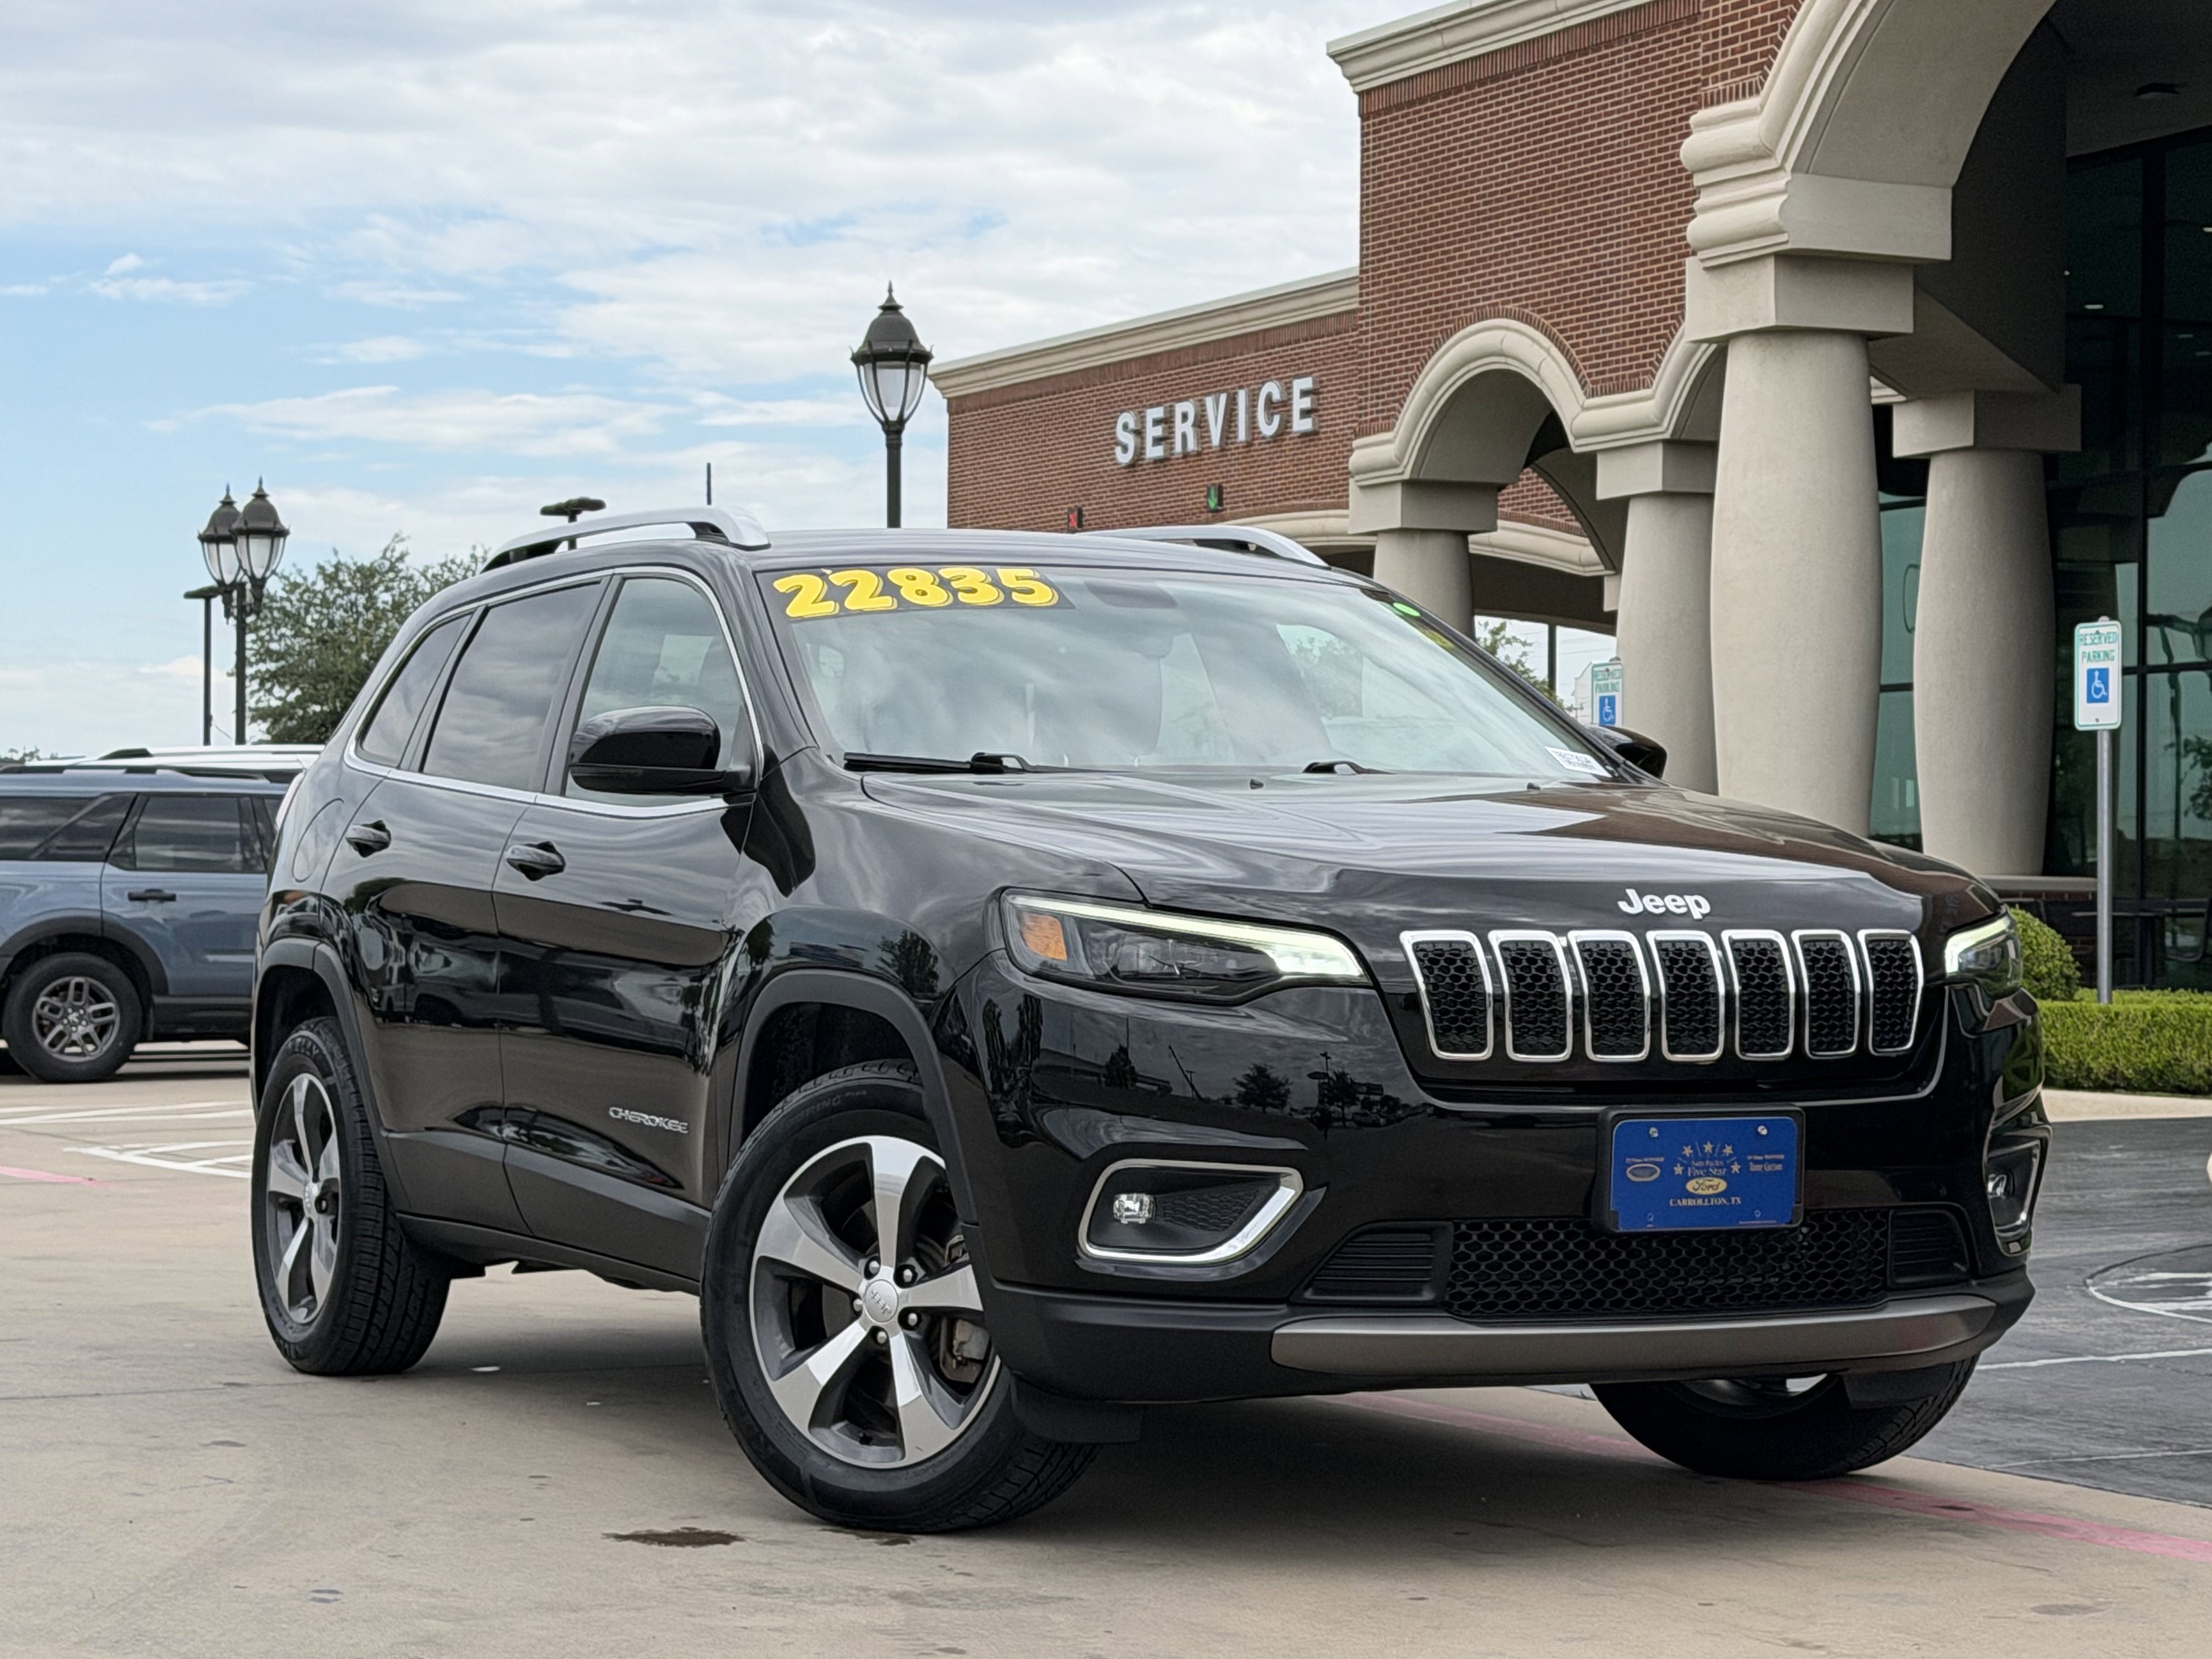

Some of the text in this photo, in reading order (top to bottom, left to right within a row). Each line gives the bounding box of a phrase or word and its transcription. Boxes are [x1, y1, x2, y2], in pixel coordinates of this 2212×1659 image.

[1115, 376, 1320, 465] SERVICE
[772, 567, 1059, 619] 22835
[2079, 631, 2118, 646] RESERVED
[2082, 650, 2115, 664] PARKING
[1617, 888, 1711, 919] Jeep
[608, 1107, 689, 1134] CHEROKEE
[1688, 1167, 1726, 1177] Five Star
[1692, 1179, 1721, 1192] Ford
[1730, 1197, 1741, 1205] TX
